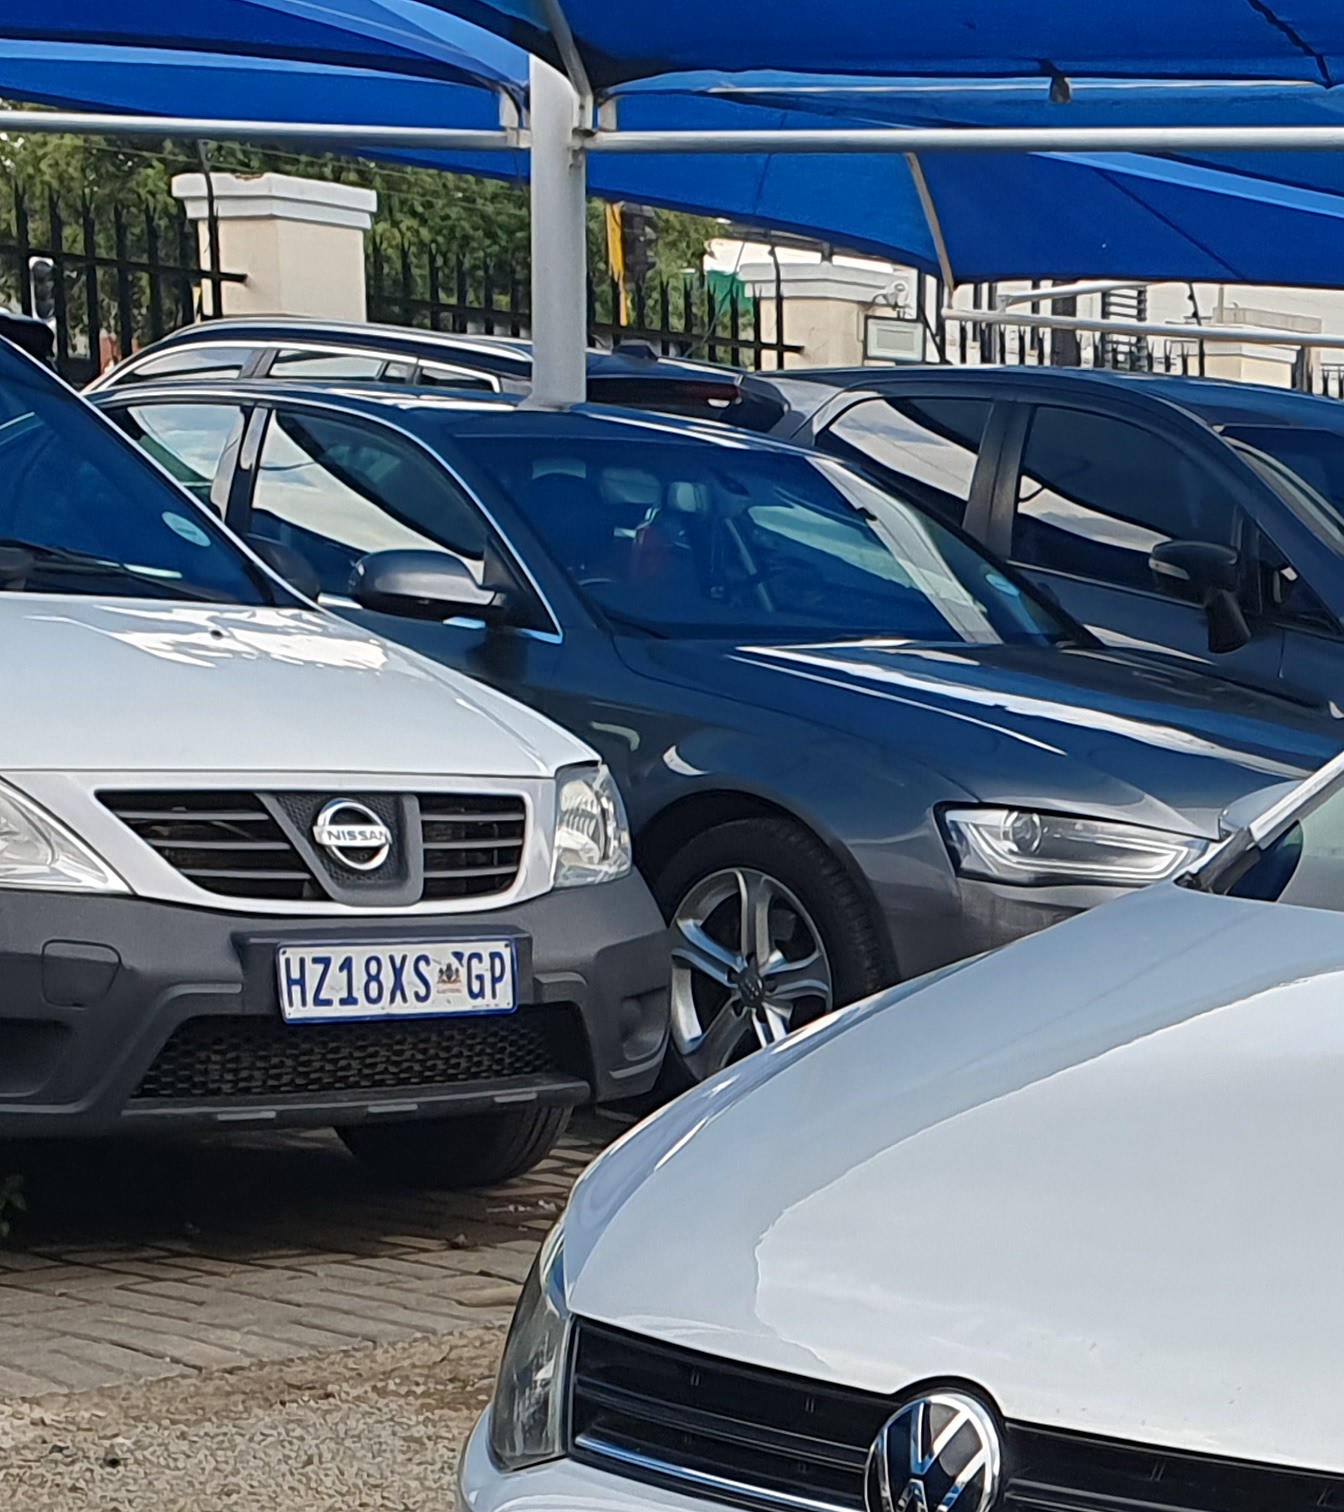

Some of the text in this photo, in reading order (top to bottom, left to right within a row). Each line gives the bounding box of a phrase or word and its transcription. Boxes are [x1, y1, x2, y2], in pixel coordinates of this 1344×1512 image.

[326, 829, 392, 844] NISSAN
[284, 951, 507, 1008] HZ18XS GP
